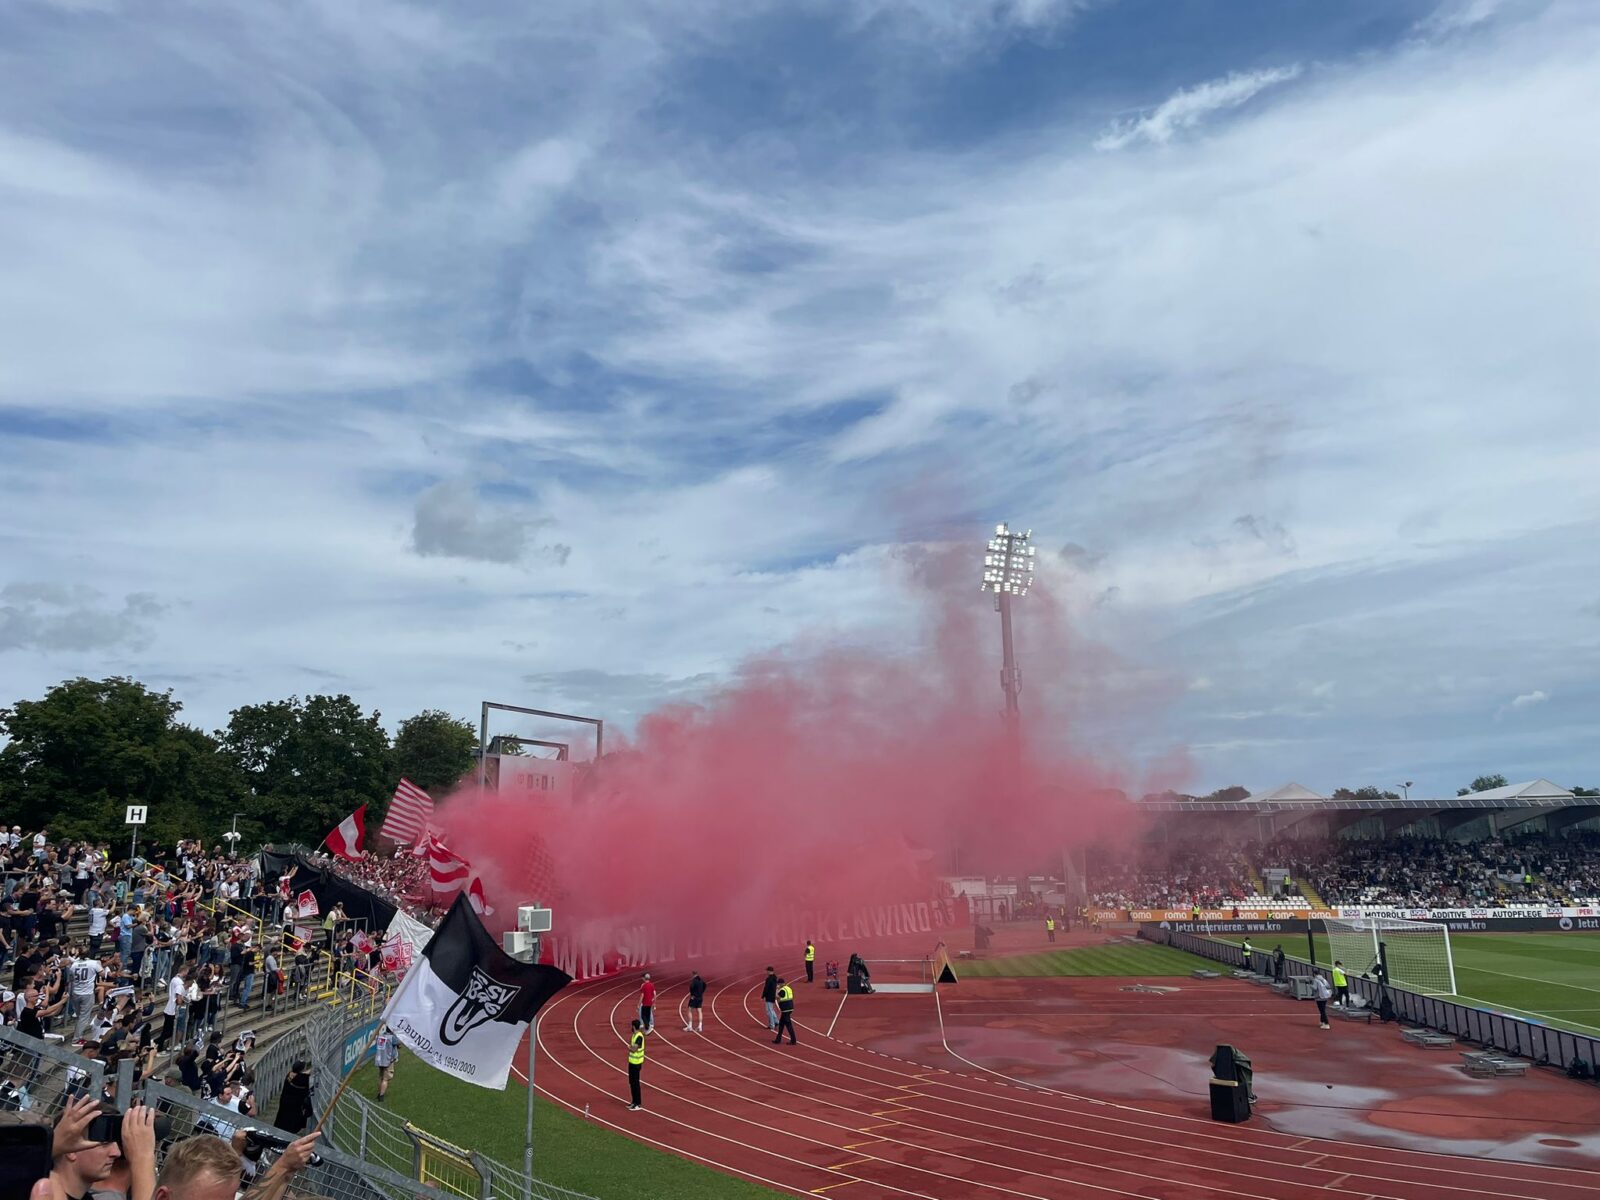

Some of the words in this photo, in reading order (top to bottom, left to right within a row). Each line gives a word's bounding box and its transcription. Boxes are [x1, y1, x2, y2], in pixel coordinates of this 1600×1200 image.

[131, 808, 143, 821] H
[1164, 911, 1187, 919] roma
[1364, 910, 1406, 919] MOTORÖLE
[1432, 911, 1467, 919] ADDITIVE
[1492, 910, 1542, 918] AUTOPFLEGE
[1175, 923, 1194, 932] Jetzt
[1578, 918, 1600, 929] Jetzt
[74, 967, 89, 981] 50
[443, 1055, 477, 1076] 1999/2000
